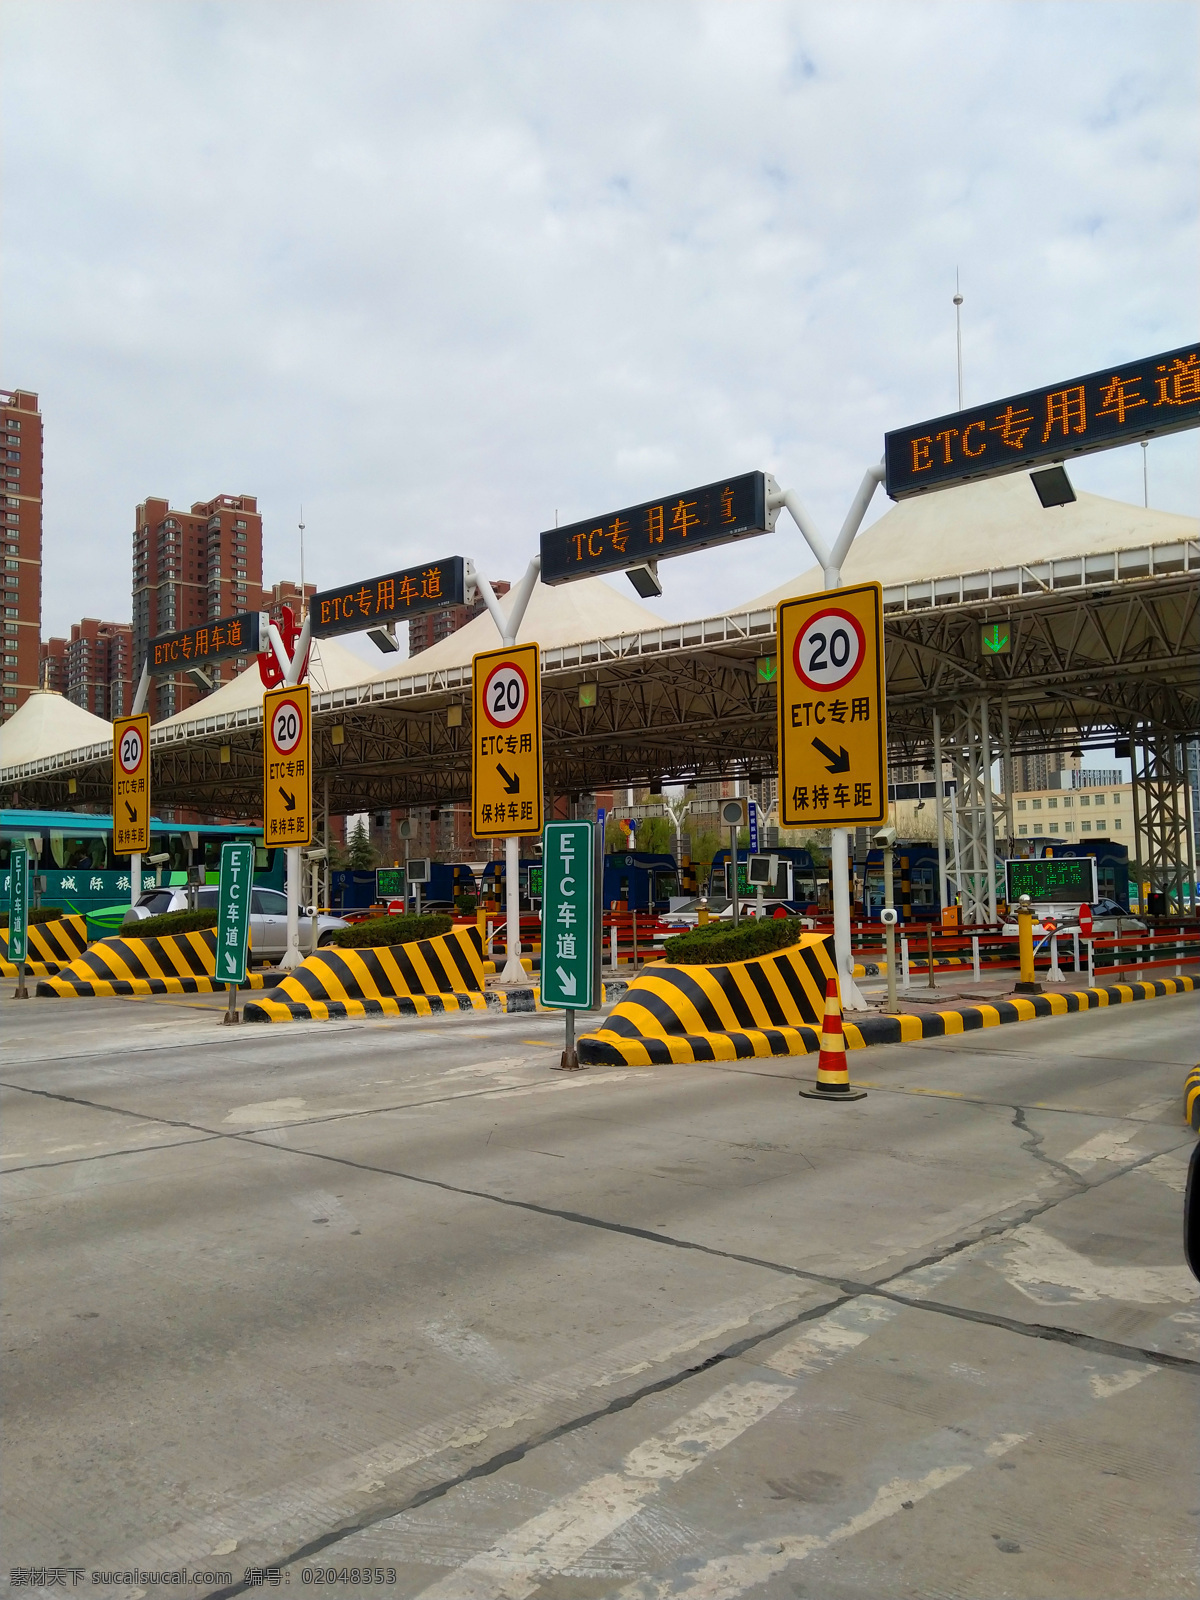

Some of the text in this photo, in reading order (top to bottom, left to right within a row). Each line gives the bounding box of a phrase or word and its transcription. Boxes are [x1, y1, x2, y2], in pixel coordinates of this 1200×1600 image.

[910, 353, 1200, 473] ETC专用车道
[319, 567, 443, 625] ETC专用车道
[154, 620, 243, 665] ETC专用车道
[808, 628, 850, 672] 20
[493, 678, 520, 713] 20
[791, 697, 870, 728] ETC专用
[277, 714, 297, 742] 20
[123, 738, 139, 762] 20
[481, 733, 532, 756] ETC专用
[269, 759, 305, 780] ETC专用
[117, 778, 145, 795] ETC专用
[792, 782, 872, 811] 保持车距
[270, 816, 305, 836] 保持车距
[481, 801, 533, 824] 保持车距
[117, 828, 145, 843] 保持车距
[13, 855, 22, 933] ETC车道
[225, 851, 241, 947] ETC车道
[556, 833, 577, 960] ETC车道
